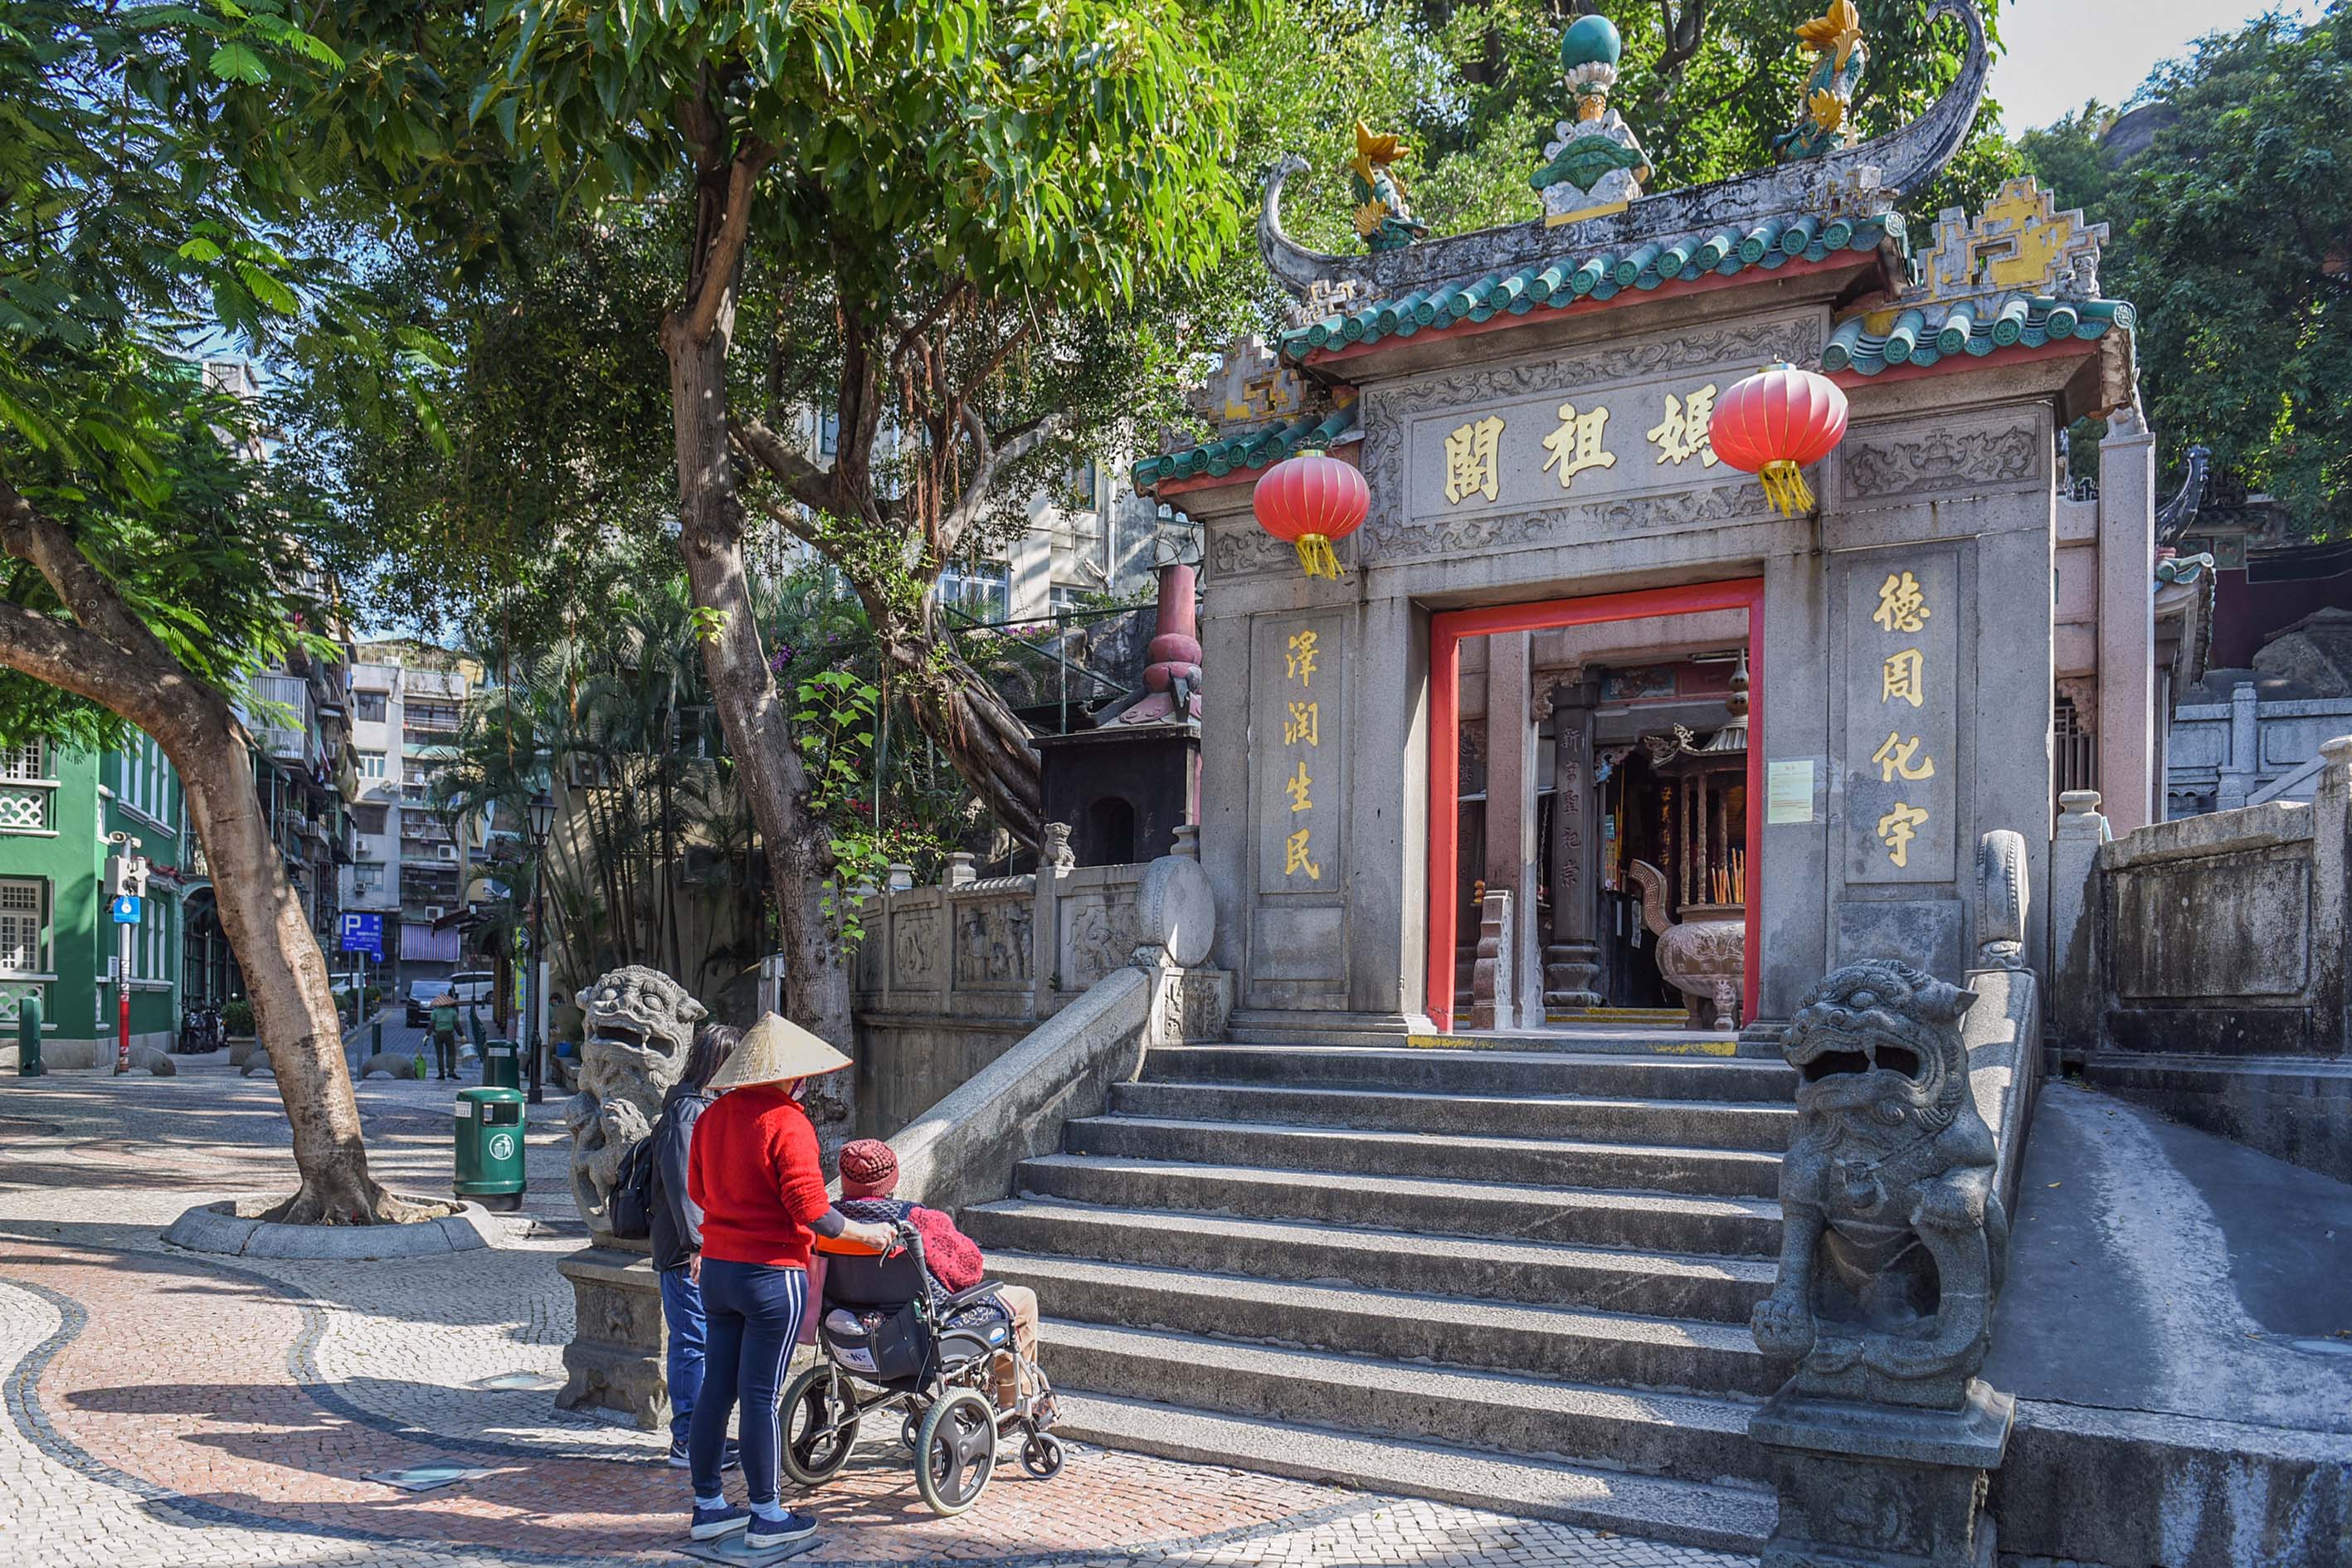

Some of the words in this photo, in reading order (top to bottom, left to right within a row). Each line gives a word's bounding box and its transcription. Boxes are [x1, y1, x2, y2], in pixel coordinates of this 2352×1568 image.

[1284, 630, 1320, 880] 澤潤生民
[1872, 571, 1936, 869] 德周化宇
[345, 914, 362, 936] P
